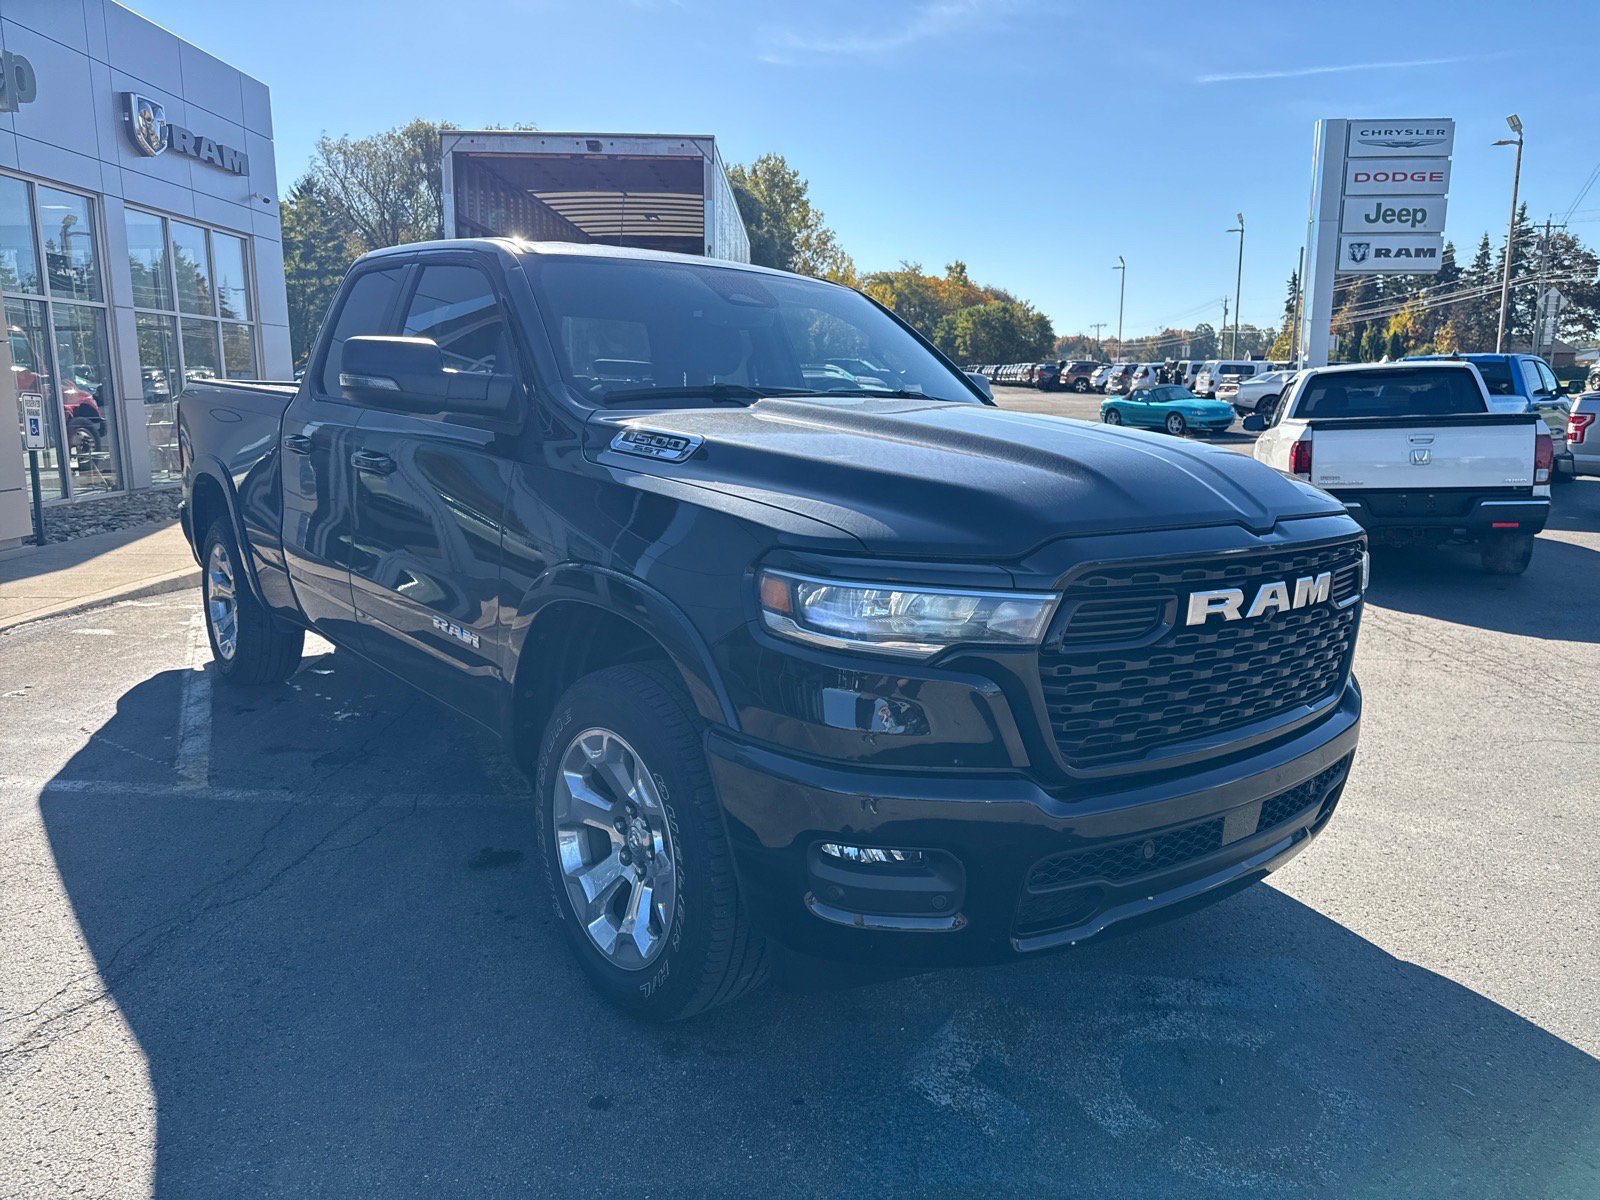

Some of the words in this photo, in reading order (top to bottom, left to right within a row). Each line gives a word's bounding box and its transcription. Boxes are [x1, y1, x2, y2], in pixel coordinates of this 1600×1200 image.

[1360, 129, 1446, 137] CHRYSLER
[166, 124, 249, 176] RAM
[1353, 171, 1444, 183] DODGE
[1364, 202, 1427, 228] Jeep
[1374, 247, 1437, 258] RAM
[25, 399, 41, 408] RESERVED
[26, 408, 41, 417] PARKING
[1186, 571, 1332, 626] RAM
[432, 614, 481, 650] RAM
